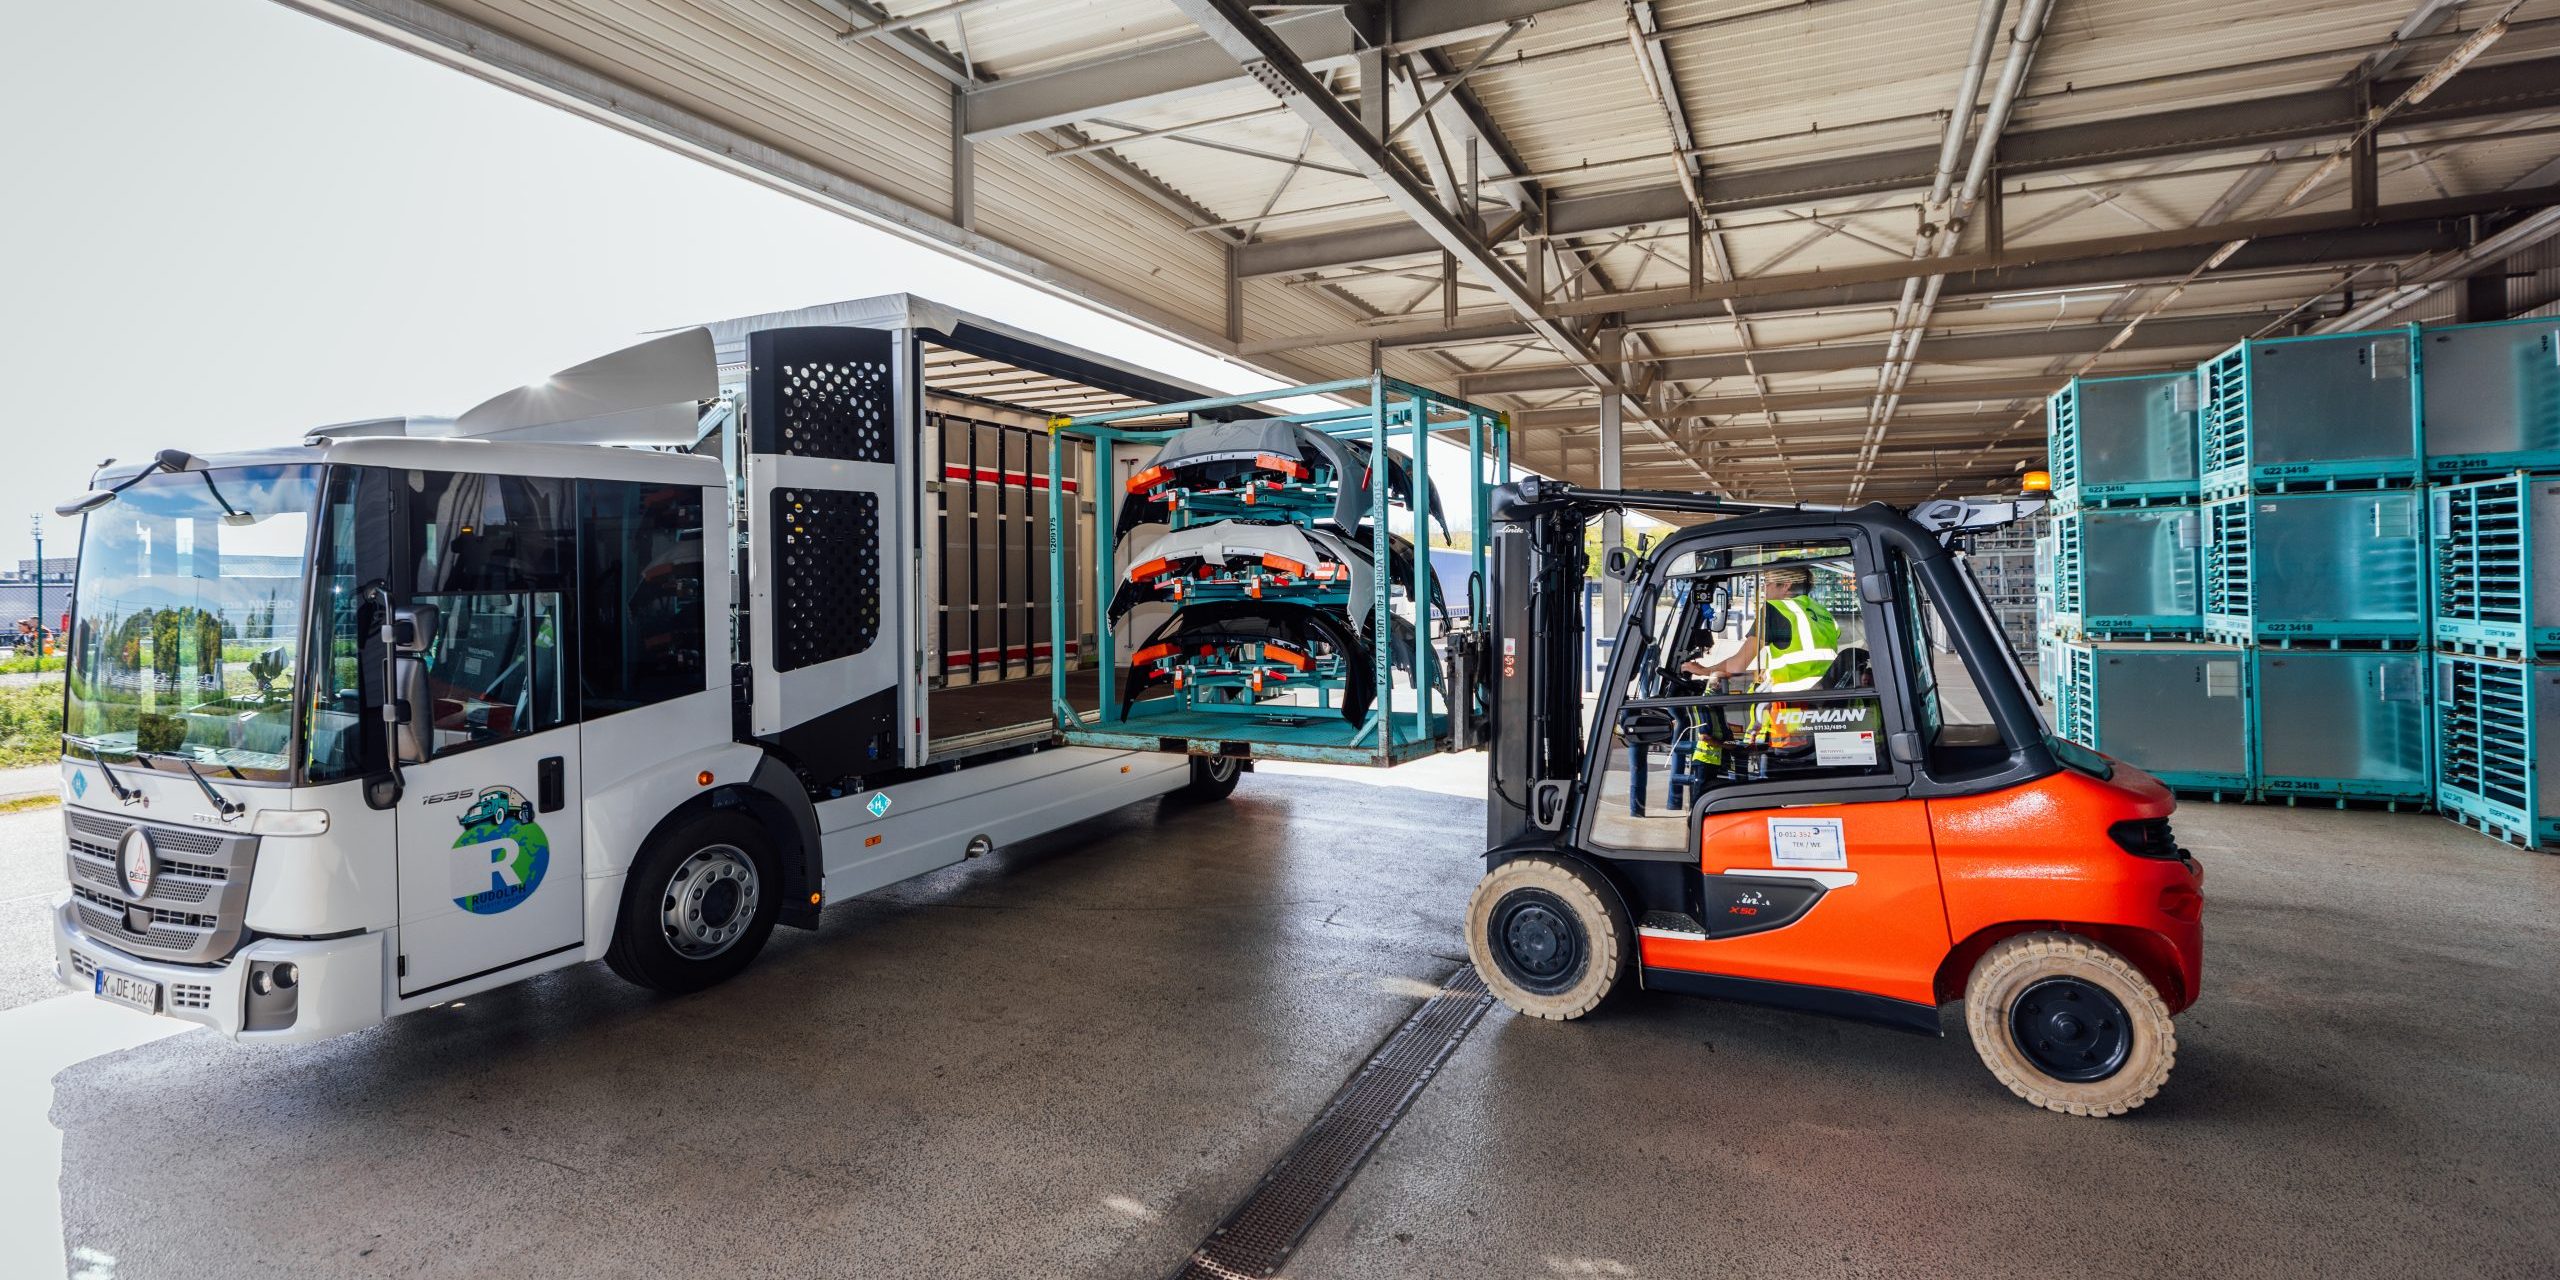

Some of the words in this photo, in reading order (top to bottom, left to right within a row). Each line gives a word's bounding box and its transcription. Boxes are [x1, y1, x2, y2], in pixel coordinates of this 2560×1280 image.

[2263, 467, 2282, 475] 622
[2284, 466, 2309, 474] 3418
[1496, 524, 1524, 533] Linde
[1375, 558, 1385, 591] VORNE
[2548, 632, 2560, 641] 62
[1776, 708, 1867, 725] HOFMANN
[2273, 780, 2292, 788] 622
[2295, 781, 2320, 789] 3418
[129, 871, 151, 881] DEUT
[472, 883, 526, 906] RUDOLPH
[103, 975, 110, 994] K
[116, 978, 129, 998] DE
[131, 982, 154, 1007] 1864
